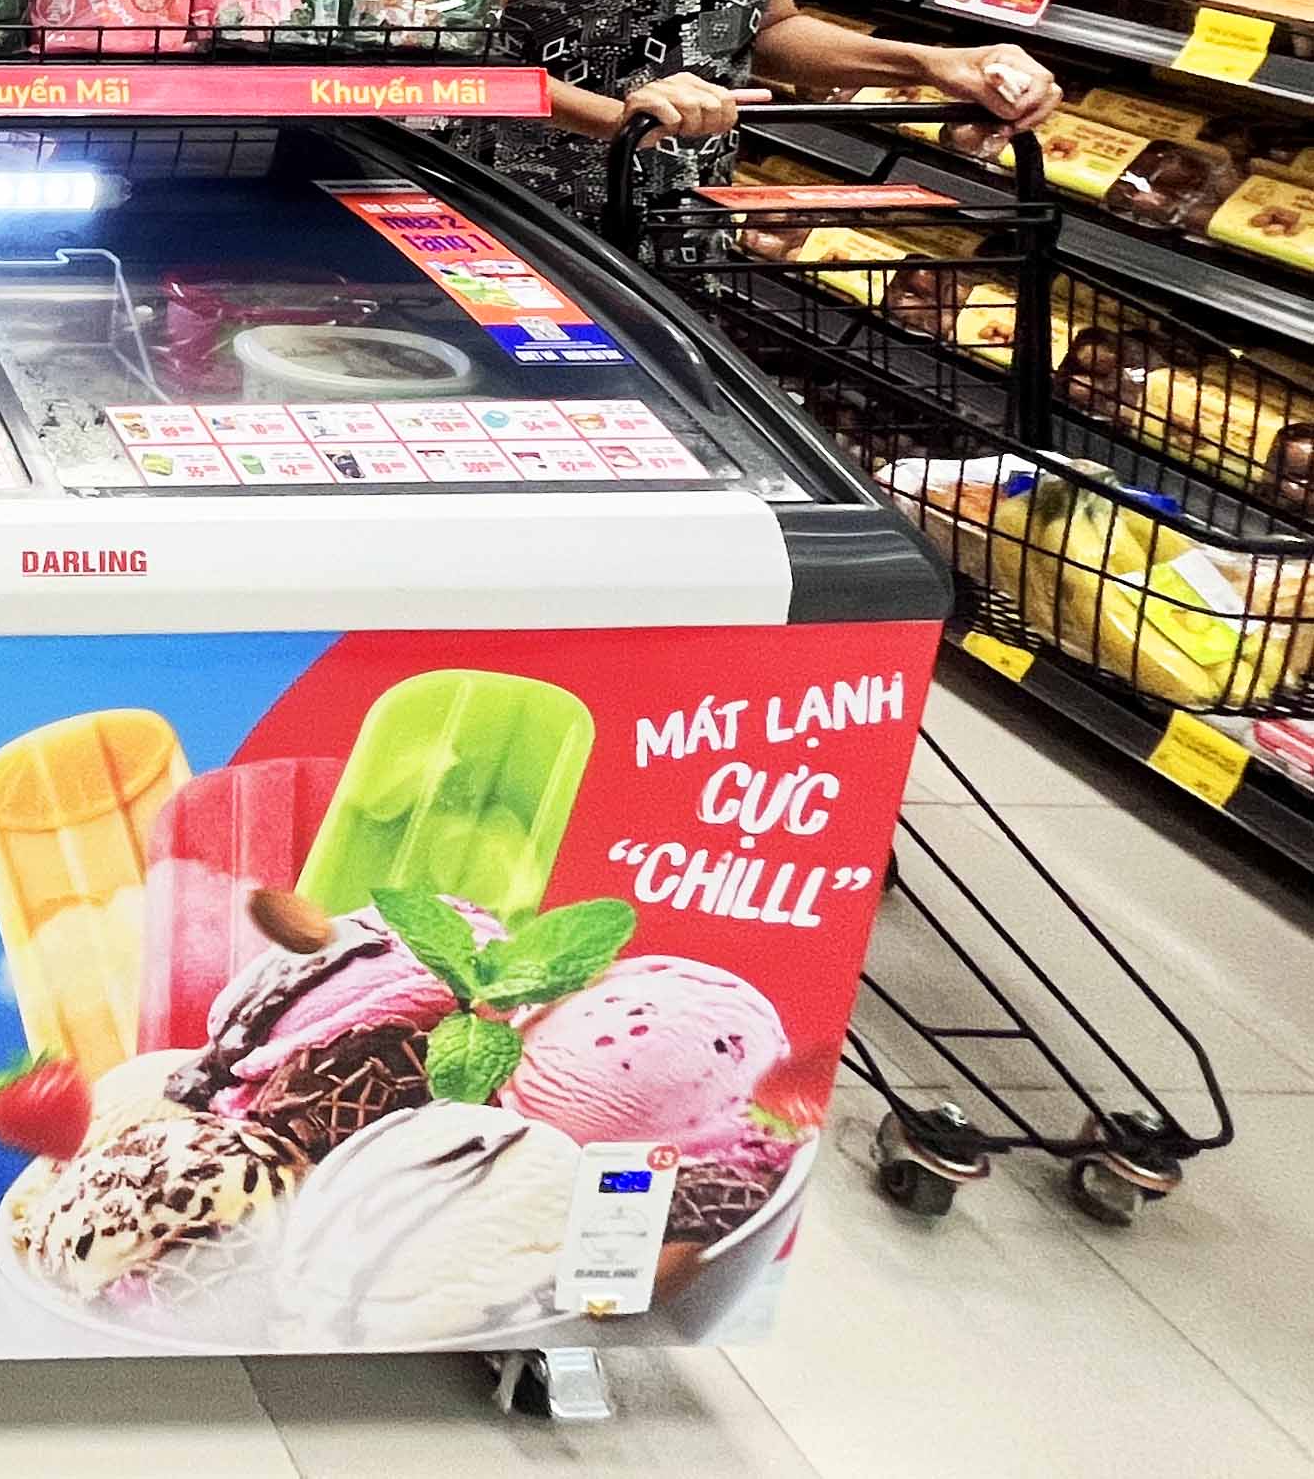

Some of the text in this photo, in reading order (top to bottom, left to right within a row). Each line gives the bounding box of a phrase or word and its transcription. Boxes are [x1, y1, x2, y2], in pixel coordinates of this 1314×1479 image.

[78, 78, 130, 104] Mãi
[312, 76, 486, 108] Khuyến Mãi
[442, 214, 467, 229] 2
[21, 549, 148, 574] DARLING
[635, 670, 904, 769] MÁT LẠNH
[696, 760, 840, 850] CỰC
[653, 1150, 673, 1165] 13
